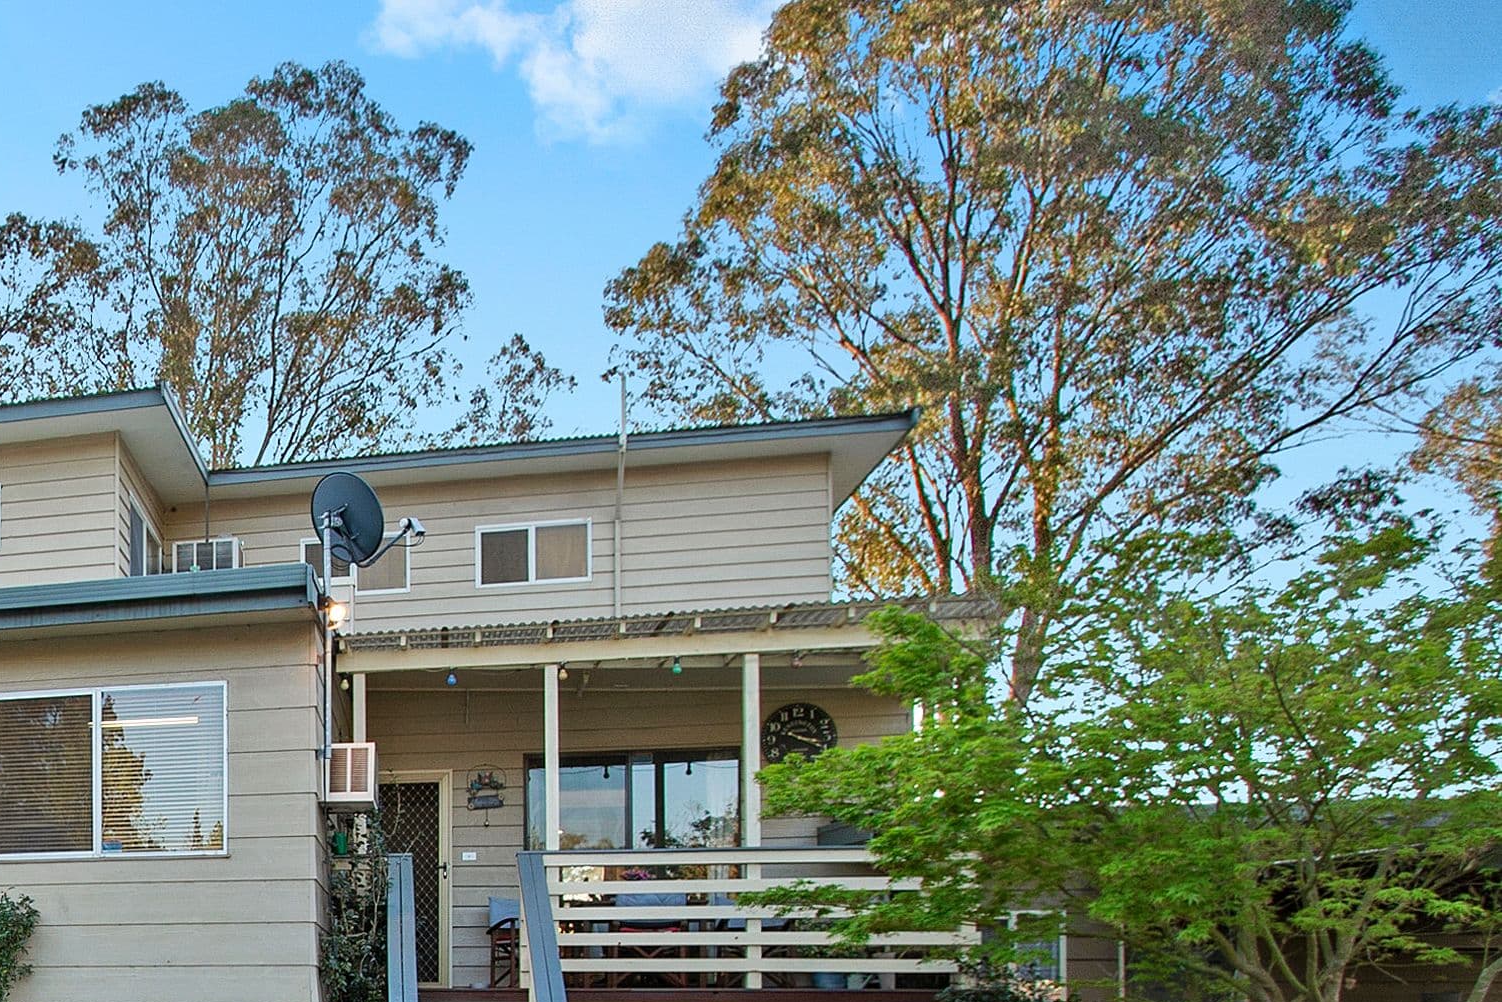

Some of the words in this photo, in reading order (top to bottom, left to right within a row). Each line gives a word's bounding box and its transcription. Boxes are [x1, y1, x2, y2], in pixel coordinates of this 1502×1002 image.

[780, 711, 789, 722] 11
[792, 707, 804, 717] 12
[769, 722, 781, 733] 10
[766, 735, 777, 745] 9
[770, 747, 780, 758] 8
